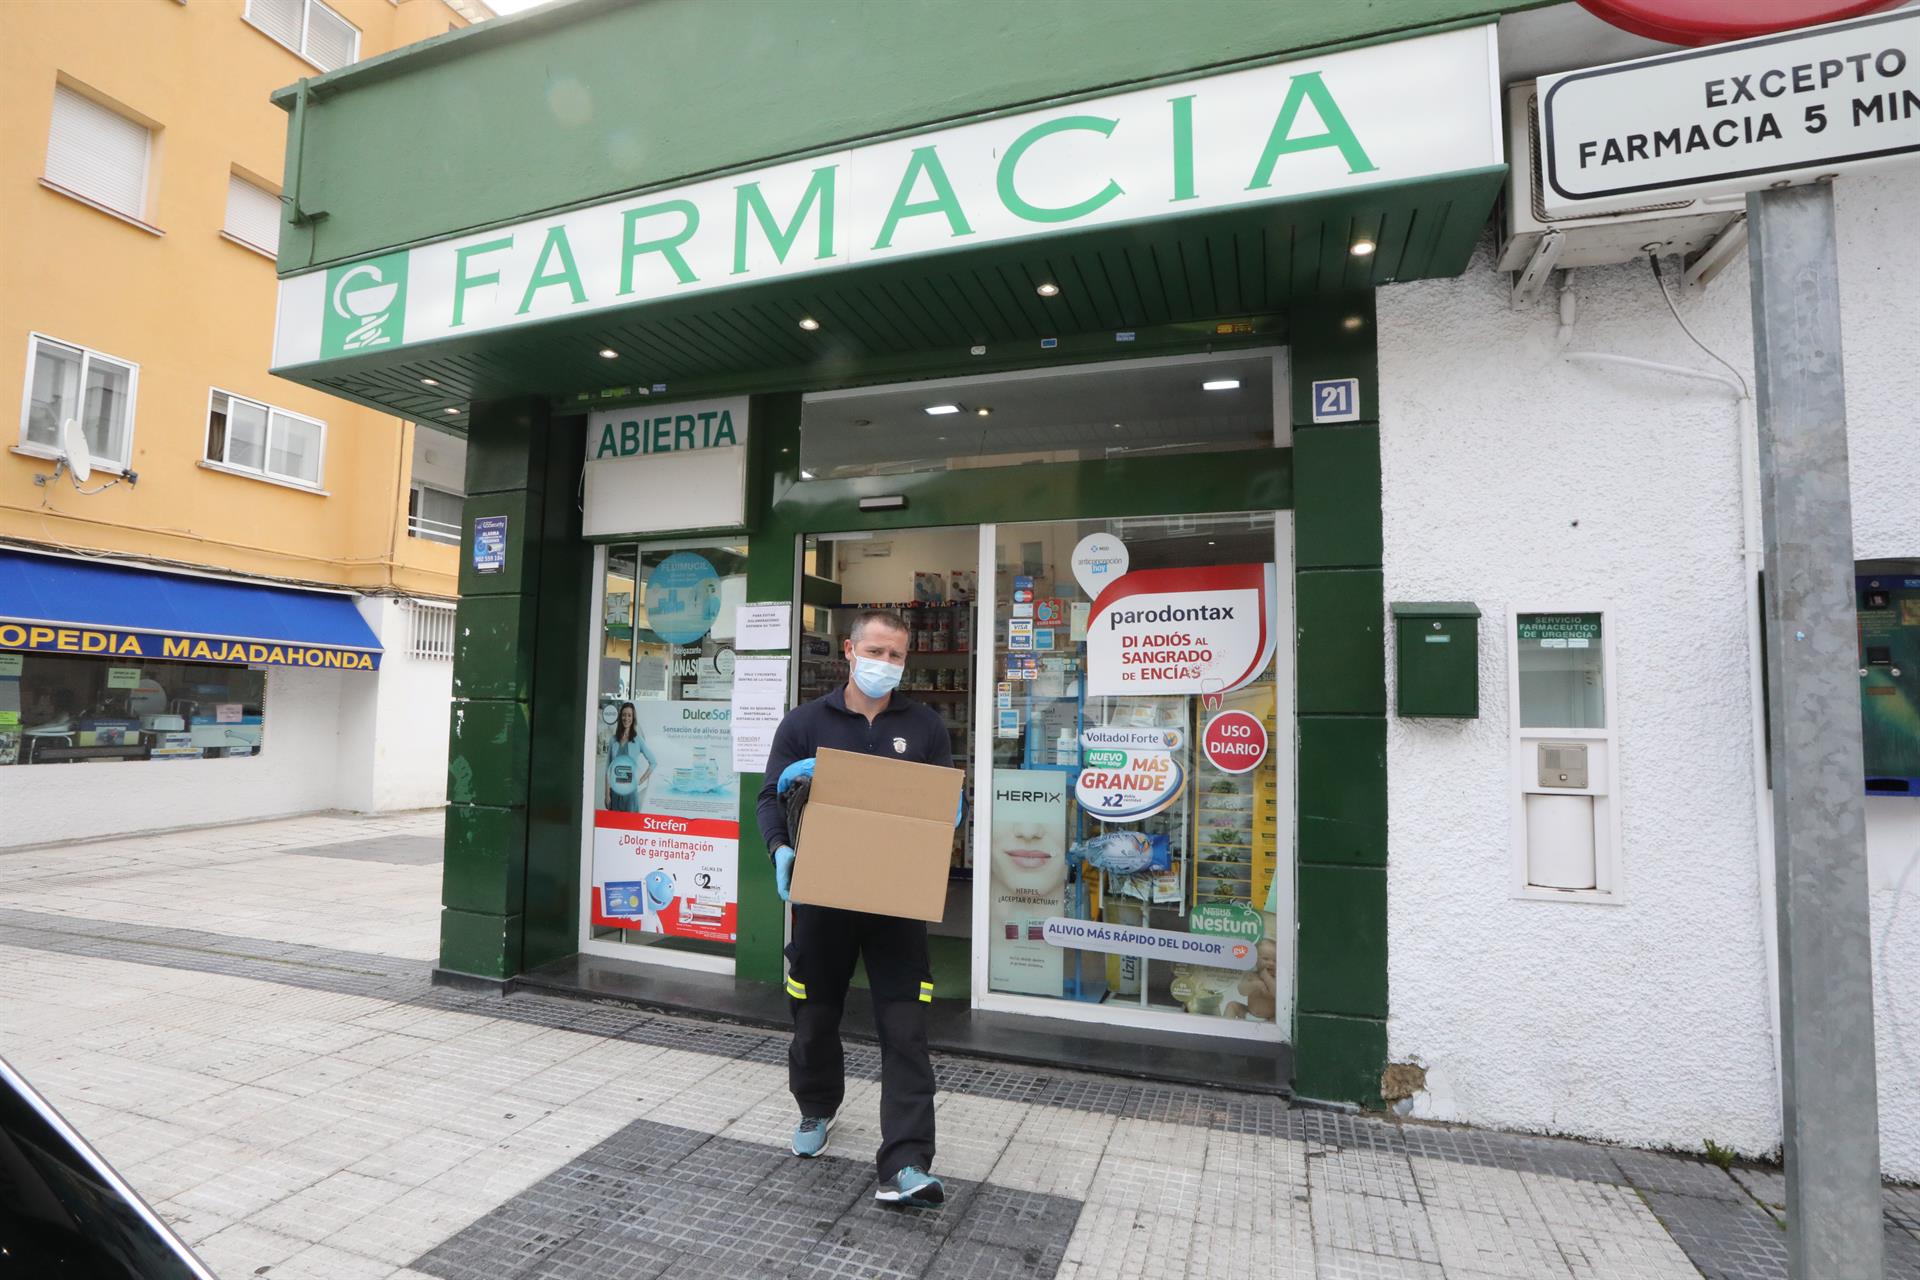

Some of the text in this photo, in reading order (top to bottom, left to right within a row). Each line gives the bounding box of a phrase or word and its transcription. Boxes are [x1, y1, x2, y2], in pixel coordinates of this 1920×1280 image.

[1705, 48, 1907, 108] EXCEPTO
[1579, 90, 1920, 169] FARMACIA 5 MIN
[448, 71, 1380, 327] FARMACIA
[1321, 385, 1347, 412] 21
[597, 410, 737, 459] ABIERTA
[1110, 605, 1235, 630] parodontax
[1535, 616, 1582, 624] SERVICIO
[1519, 623, 1598, 631] FARMACEUTICO
[0, 624, 374, 670] OPEDIA MAJADAHONDA
[1122, 631, 1208, 648] DI ADIÓS AL
[1122, 650, 1212, 665] SANGRADO
[672, 659, 700, 676] ANAS
[1122, 664, 1201, 681] DE ENCÍAS
[701, 726, 719, 735] alivio
[1086, 732, 1159, 743] Voltadol Forte
[1221, 725, 1251, 738] USO
[1089, 752, 1123, 761] NUEVO
[1210, 742, 1260, 756] DIARIO
[1132, 755, 1169, 772] MÁS
[1081, 772, 1167, 791] GRANDE
[996, 790, 1061, 803] HERPIX
[1102, 793, 1124, 807] x2
[643, 817, 687, 832] Strefen
[618, 835, 648, 846] ¿Dolor
[658, 838, 714, 852] inflamación
[635, 847, 696, 861] de garganta?
[702, 873, 711, 889] 2
[1191, 915, 1258, 935] Nestum
[1048, 923, 1085, 937] ALIVIO
[1086, 926, 1111, 940] MÁS
[1113, 930, 1156, 947] RÁPIDO
[1158, 937, 1179, 950] DEL
